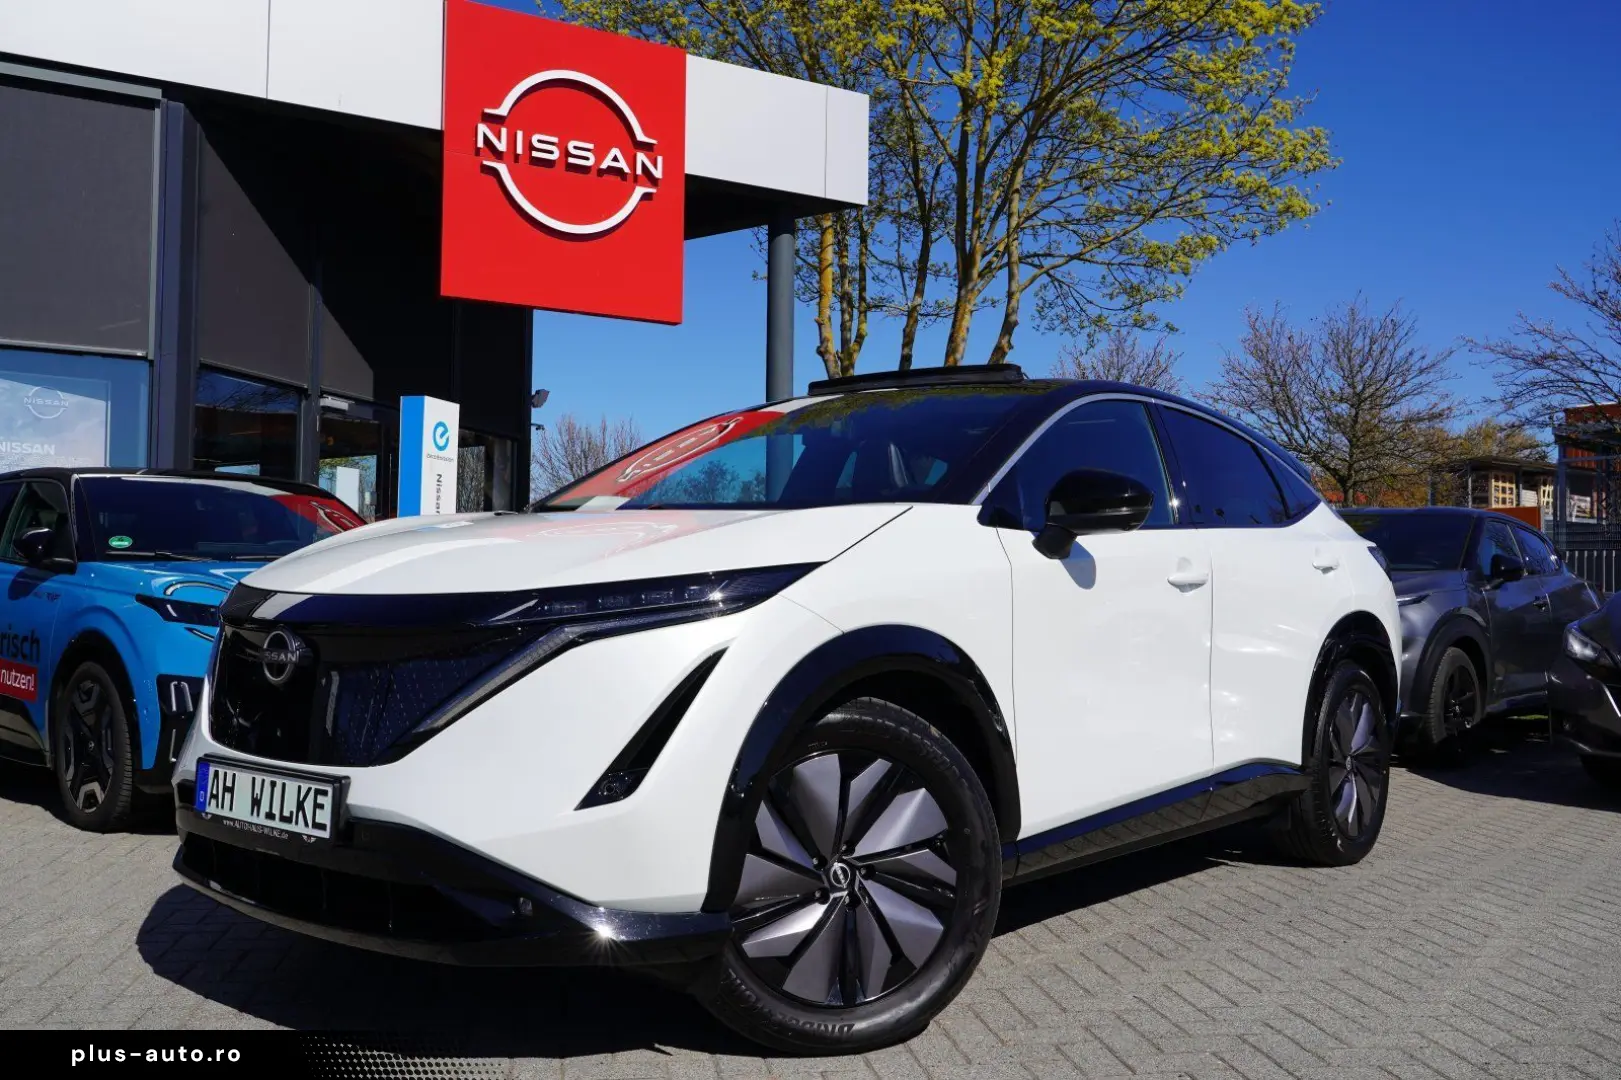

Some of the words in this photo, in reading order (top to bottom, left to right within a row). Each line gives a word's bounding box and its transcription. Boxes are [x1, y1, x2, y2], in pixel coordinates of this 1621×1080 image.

[477, 123, 663, 179] NISSAN
[24, 397, 68, 407] NISSAN
[0, 668, 35, 692] nutzen!
[208, 769, 237, 811] AH
[250, 776, 329, 831] WILKE
